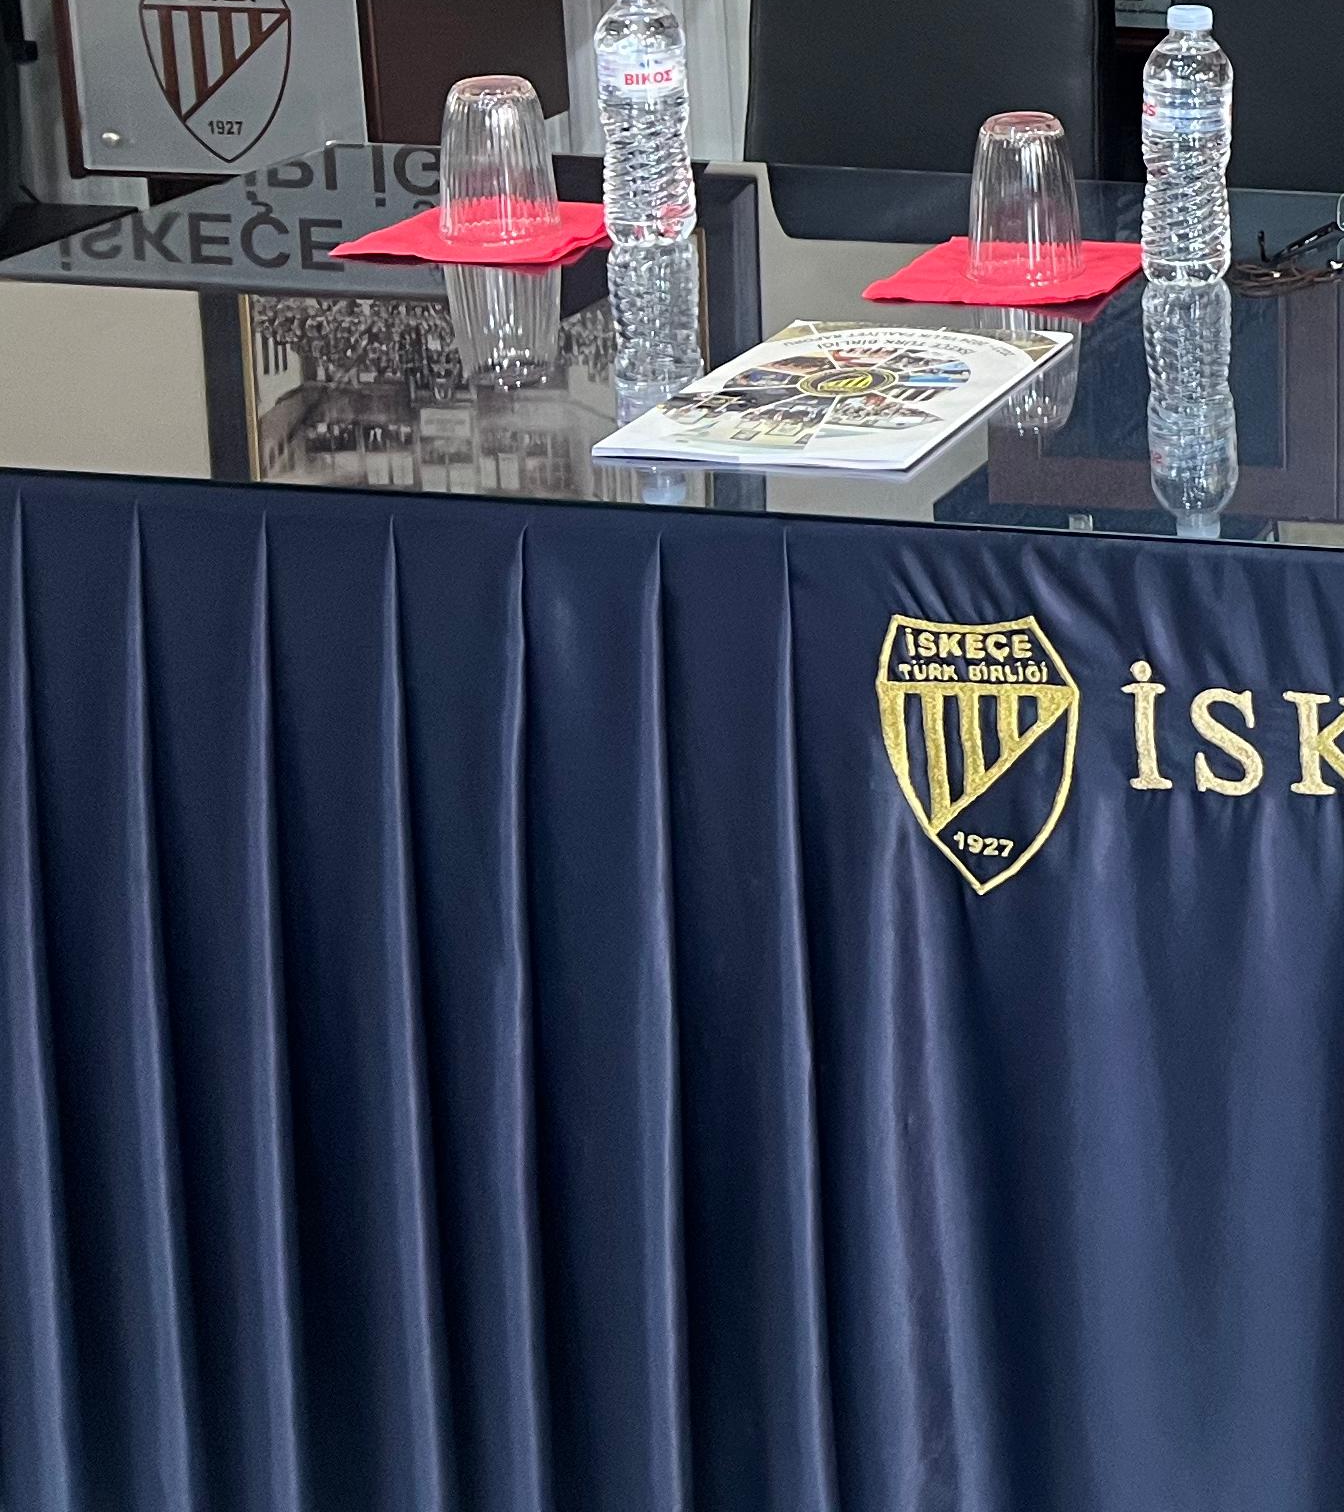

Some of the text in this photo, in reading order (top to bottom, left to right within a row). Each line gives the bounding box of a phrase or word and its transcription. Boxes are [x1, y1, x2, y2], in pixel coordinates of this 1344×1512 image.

[207, 120, 244, 136] 1927
[904, 627, 1033, 662] İSKEÇE
[898, 660, 1049, 683] TÜRK BİRLİĞİ
[953, 831, 1014, 858] 1927
